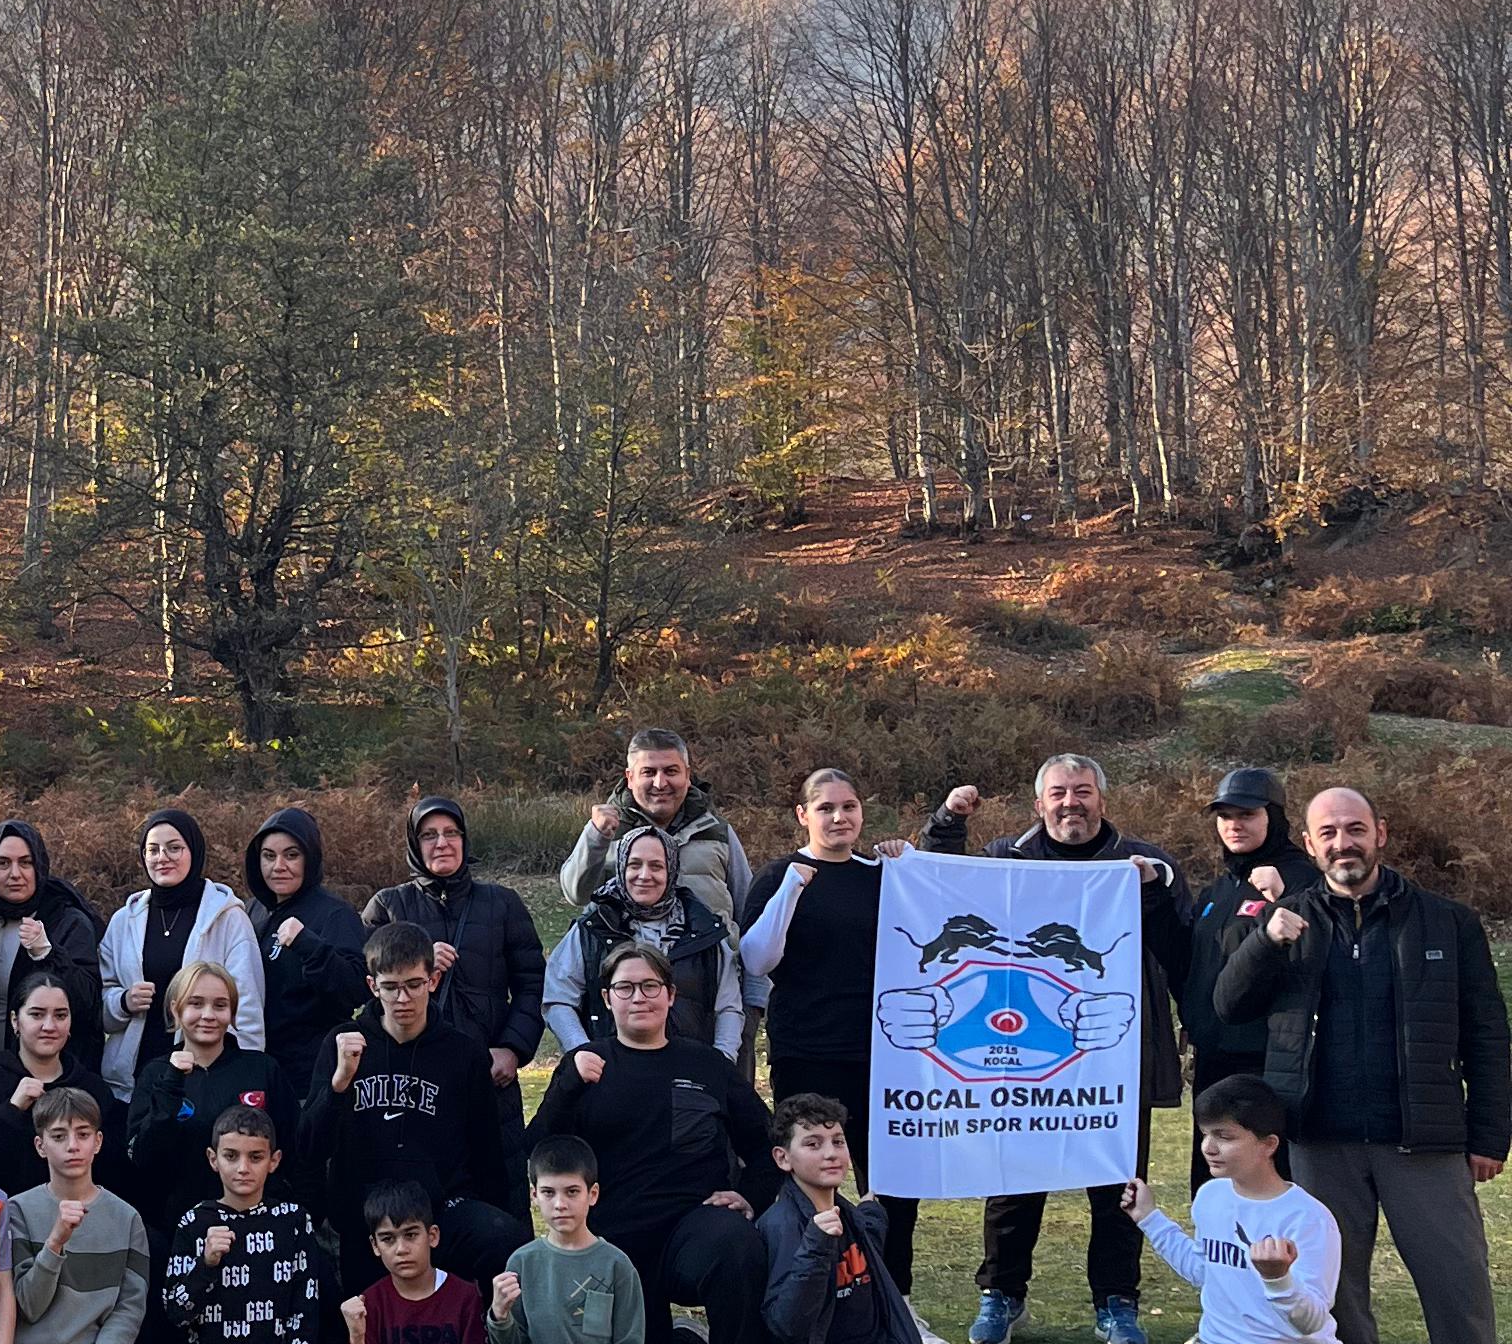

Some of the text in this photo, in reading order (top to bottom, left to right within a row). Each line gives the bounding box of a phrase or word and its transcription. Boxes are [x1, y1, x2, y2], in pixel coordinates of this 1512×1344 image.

[354, 1074, 439, 1116] NIKE
[884, 1084, 1124, 1111] KOCAL OSMANLI
[888, 1112, 1119, 1138] EĞİTİM SPOR KULÜBÜ
